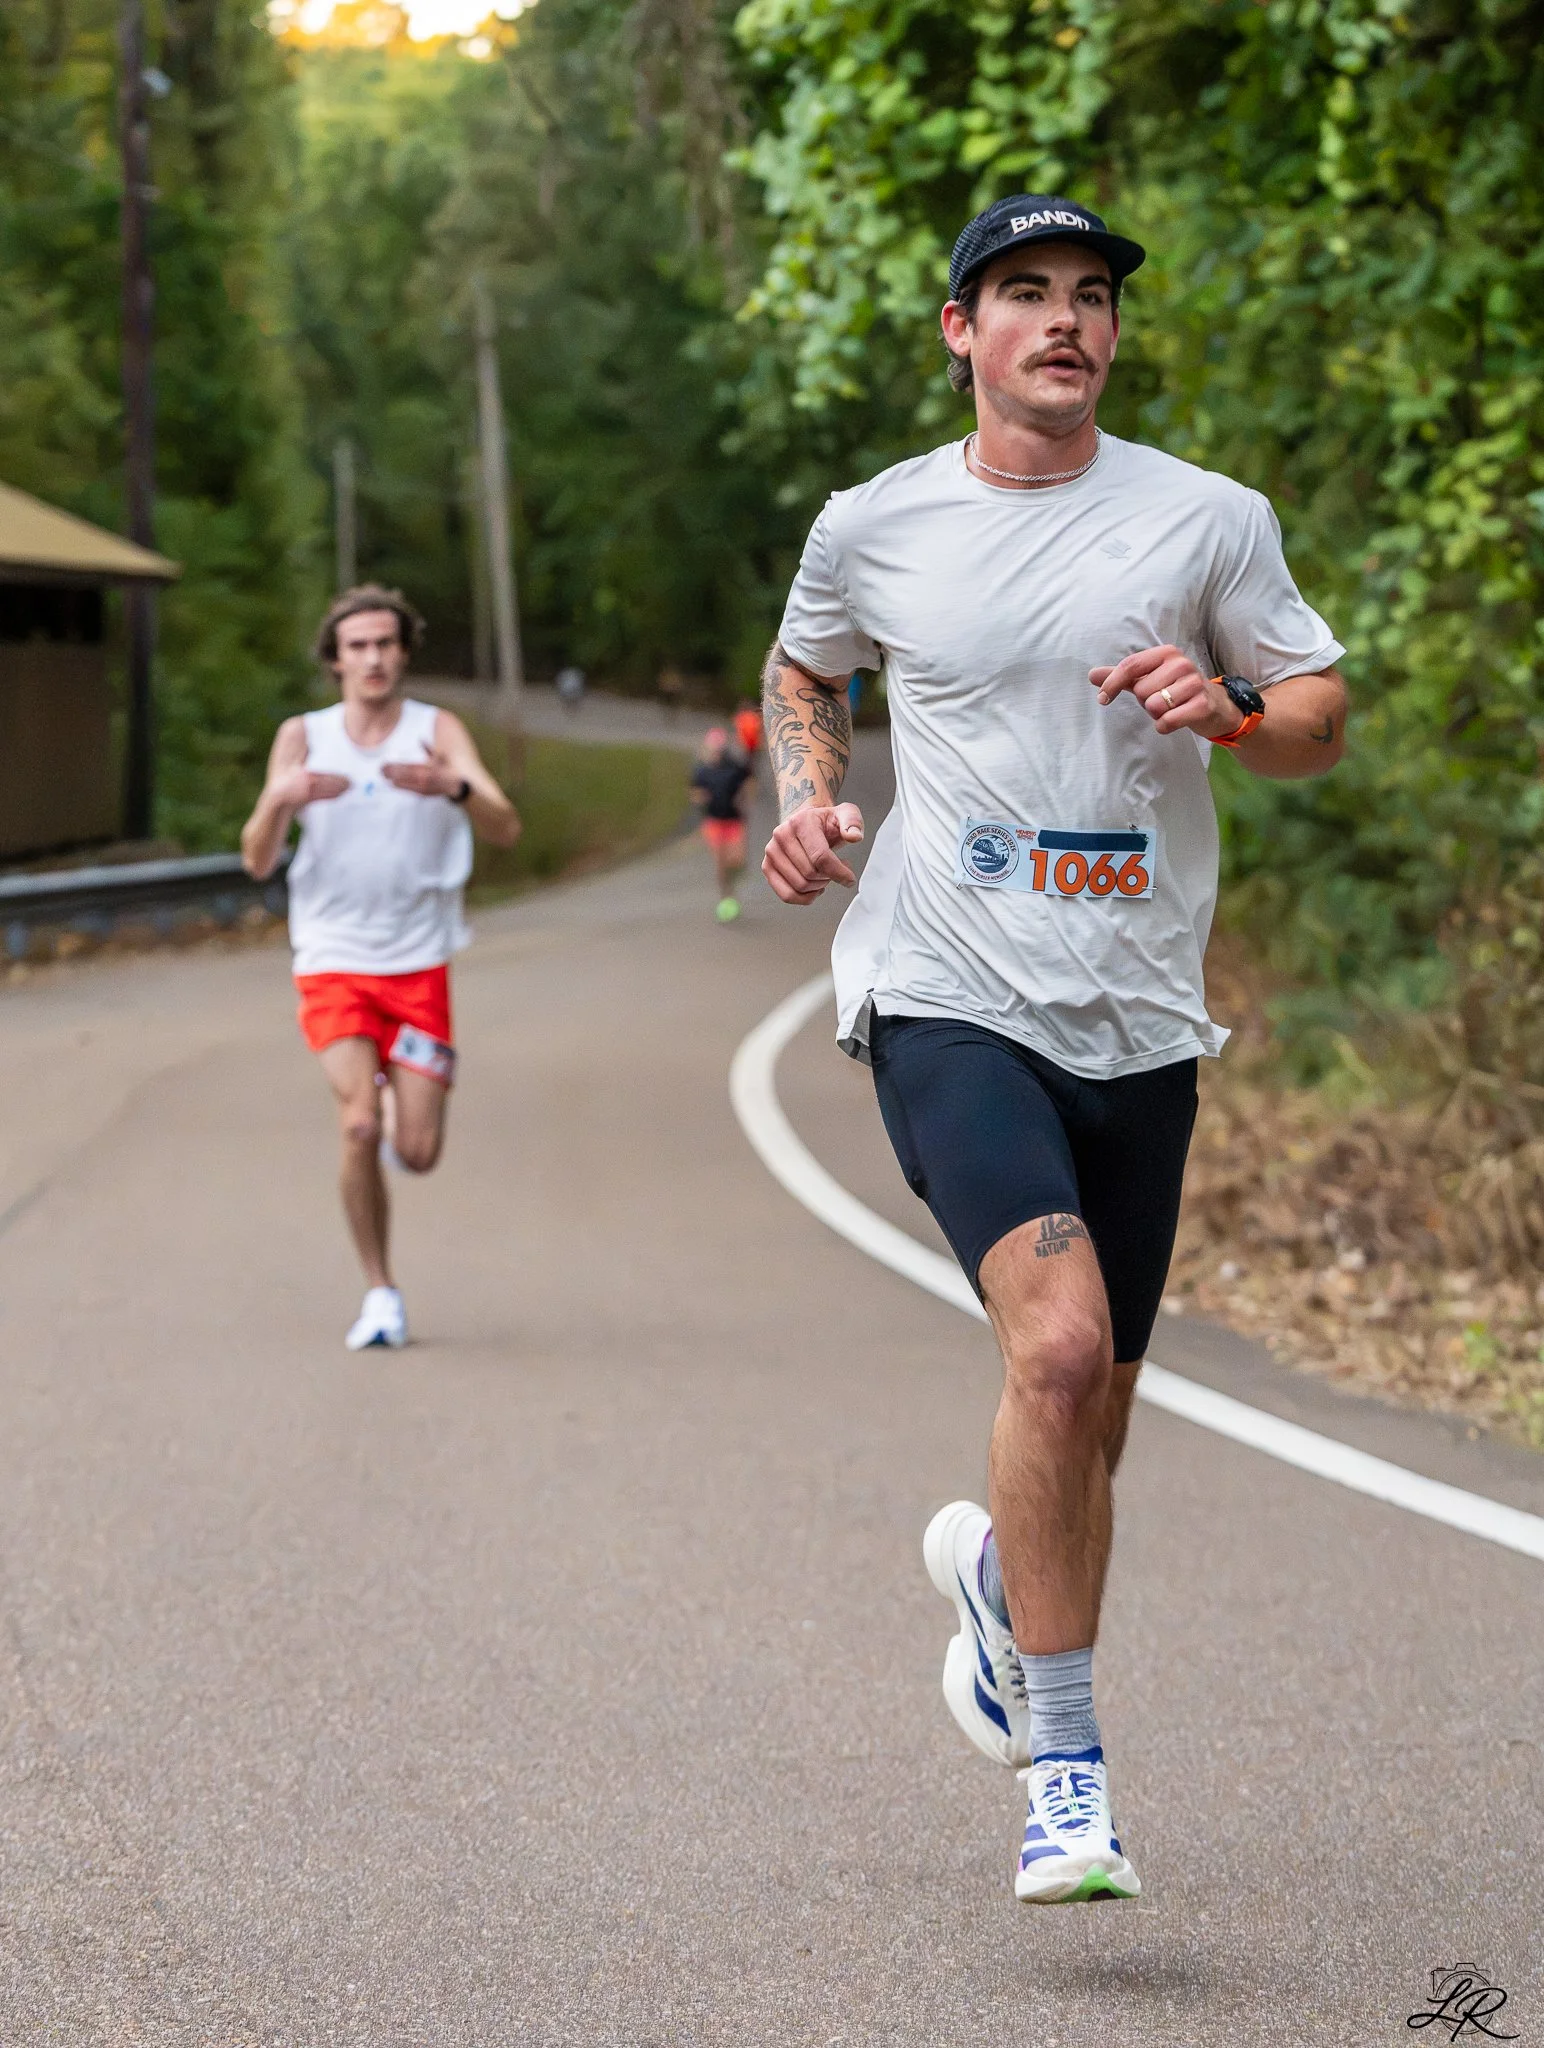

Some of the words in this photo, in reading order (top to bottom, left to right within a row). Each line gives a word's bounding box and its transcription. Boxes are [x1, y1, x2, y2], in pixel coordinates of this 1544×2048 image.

[966, 832, 978, 847] ROAD
[976, 827, 991, 835] RACE
[991, 827, 1009, 840] SERIES
[1029, 849, 1150, 896] 1066
